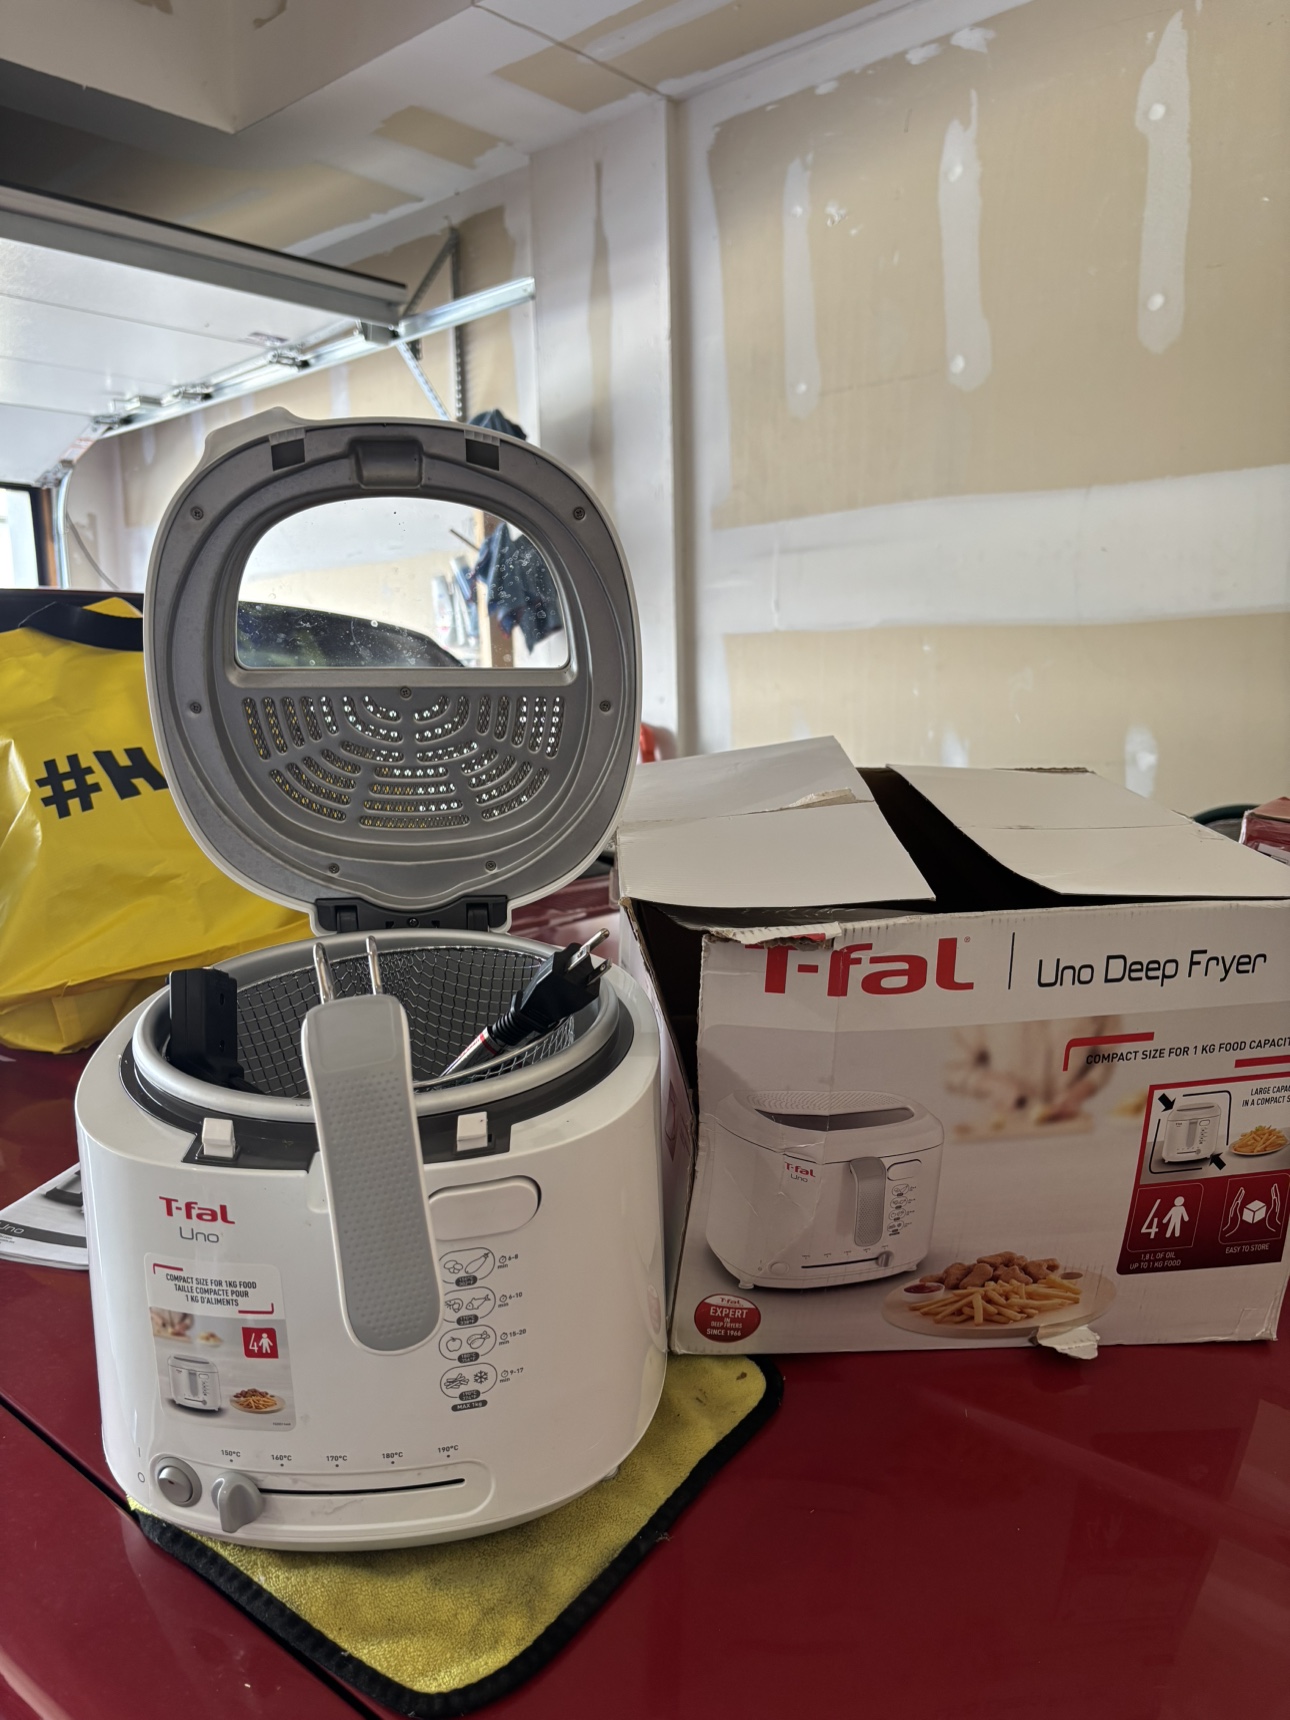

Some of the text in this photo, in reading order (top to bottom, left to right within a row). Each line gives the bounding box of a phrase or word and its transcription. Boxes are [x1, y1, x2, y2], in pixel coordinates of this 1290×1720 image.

[1037, 949, 1267, 988] Uno Deep Fryer
[1086, 1050, 1138, 1065] COMPACT
[1141, 1048, 1165, 1060] SIZE
[1168, 1046, 1190, 1058] FOR
[1193, 1046, 1198, 1056] 1
[1201, 1044, 1216, 1055] KG
[1218, 1040, 1247, 1053] FOOD
[1250, 1086, 1271, 1096] LARGE
[1242, 1099, 1249, 1107] IN
[1250, 1098, 1255, 1106] A
[1256, 1096, 1286, 1106] COMPACT
[785, 1162, 816, 1178] T-fal
[791, 1173, 808, 1183] Uno
[159, 1196, 236, 1225] T-fal
[1141, 1199, 1162, 1239] 4
[179, 1226, 219, 1243] Uno
[1225, 1246, 1241, 1254] EASY
[1251, 1243, 1270, 1252] STORE
[1164, 1259, 1181, 1267] FOOD
[166, 1273, 257, 1289] COMPACT SIZE FOR 1KG FOOD
[174, 1284, 249, 1298] TAILLE COMPACTE POUR
[190, 1295, 199, 1303] KG
[200, 1296, 239, 1306] D'ALIMENTS
[710, 1306, 748, 1319] EXPERT
[509, 1329, 526, 1338] 15-20
[707, 1328, 725, 1336] SINCE
[248, 1333, 259, 1353] 4
[509, 1367, 524, 1375] 9-17
[221, 1449, 241, 1458] 150°C
[437, 1444, 459, 1454] 190°C
[271, 1454, 292, 1462] 160°C
[326, 1454, 348, 1462] 170°C
[382, 1451, 403, 1460] 180°C
